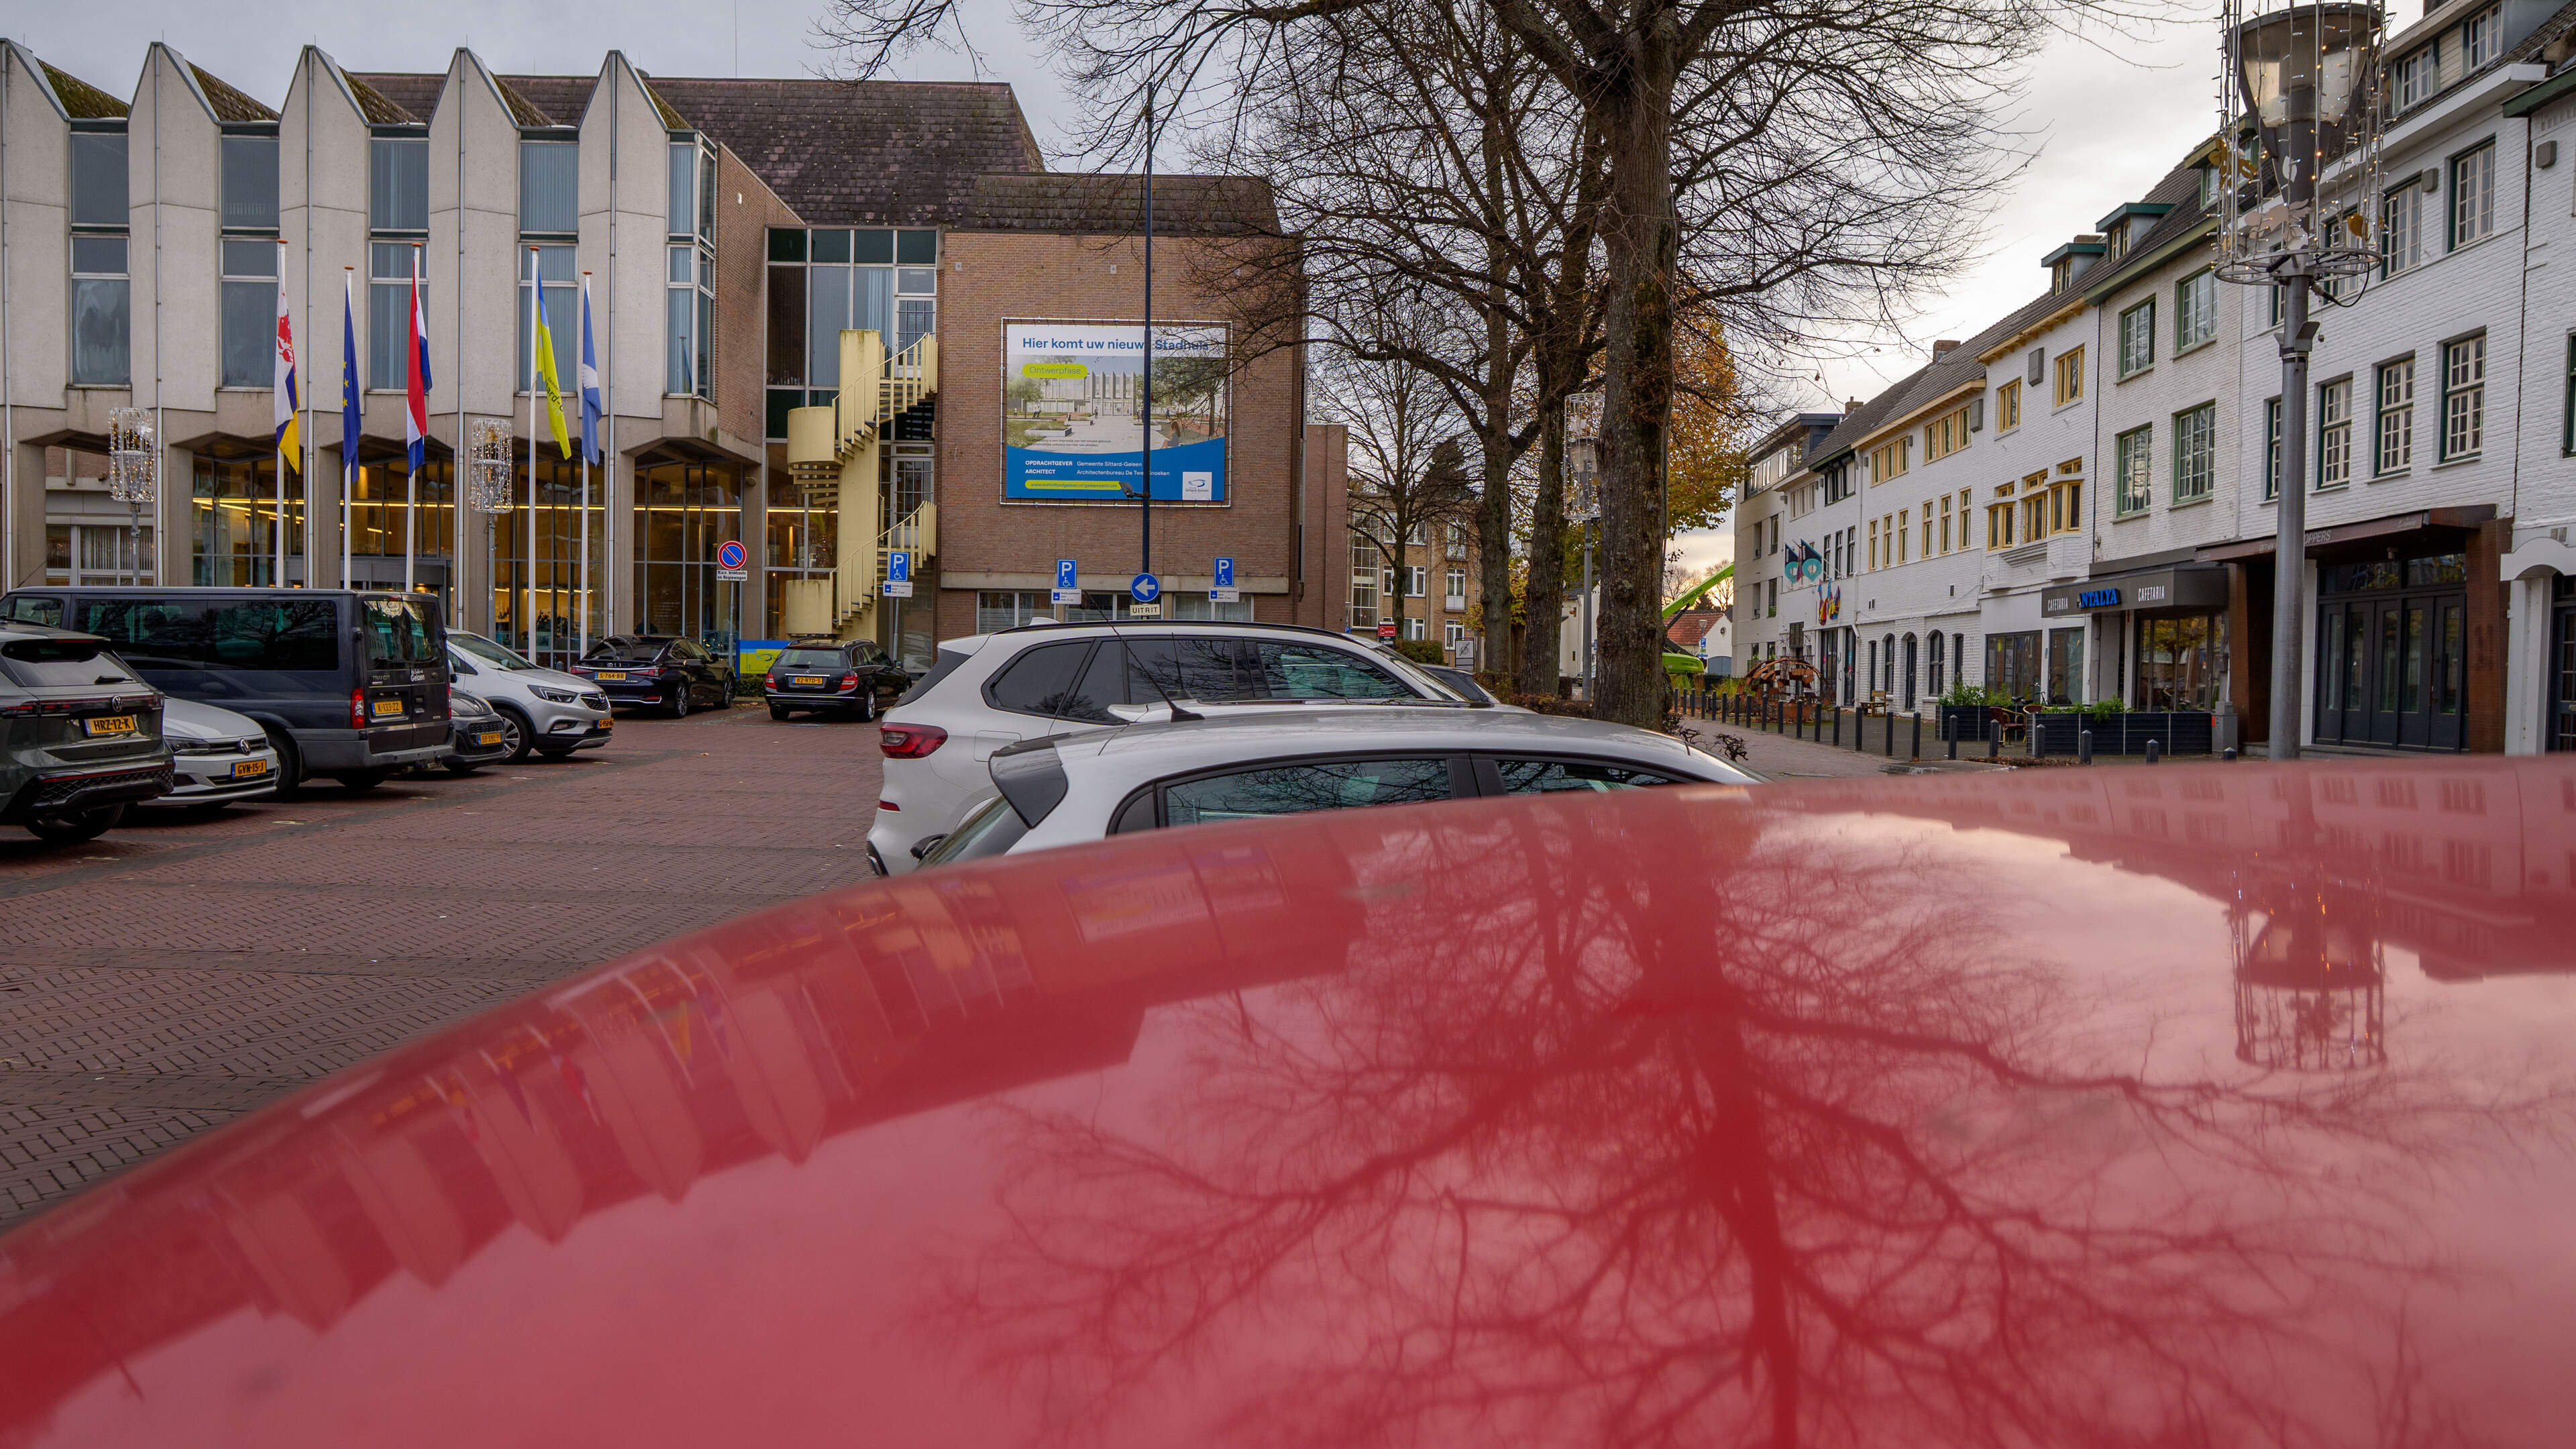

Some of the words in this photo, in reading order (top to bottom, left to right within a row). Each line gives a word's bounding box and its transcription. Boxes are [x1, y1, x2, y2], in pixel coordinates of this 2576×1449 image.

[1023, 337, 1049, 348] Hier
[1051, 338, 1083, 349] komt
[1086, 341, 1105, 349] uw
[1108, 339, 1145, 350] nieuw
[1029, 366, 1081, 375] Ontwerpfase
[2304, 530, 2331, 545] OPPERS
[894, 555, 904, 569] P
[1061, 562, 1072, 576] P
[1219, 559, 1229, 574] P
[2047, 597, 2068, 612] CAFETARIA
[2078, 588, 2118, 608] NTALYA
[2138, 585, 2165, 602] CAFETARIA
[378, 702, 399, 712] X-133-ZZ
[93, 717, 131, 731] HRZ-12-K
[237, 762, 264, 774] GVN-15-J
